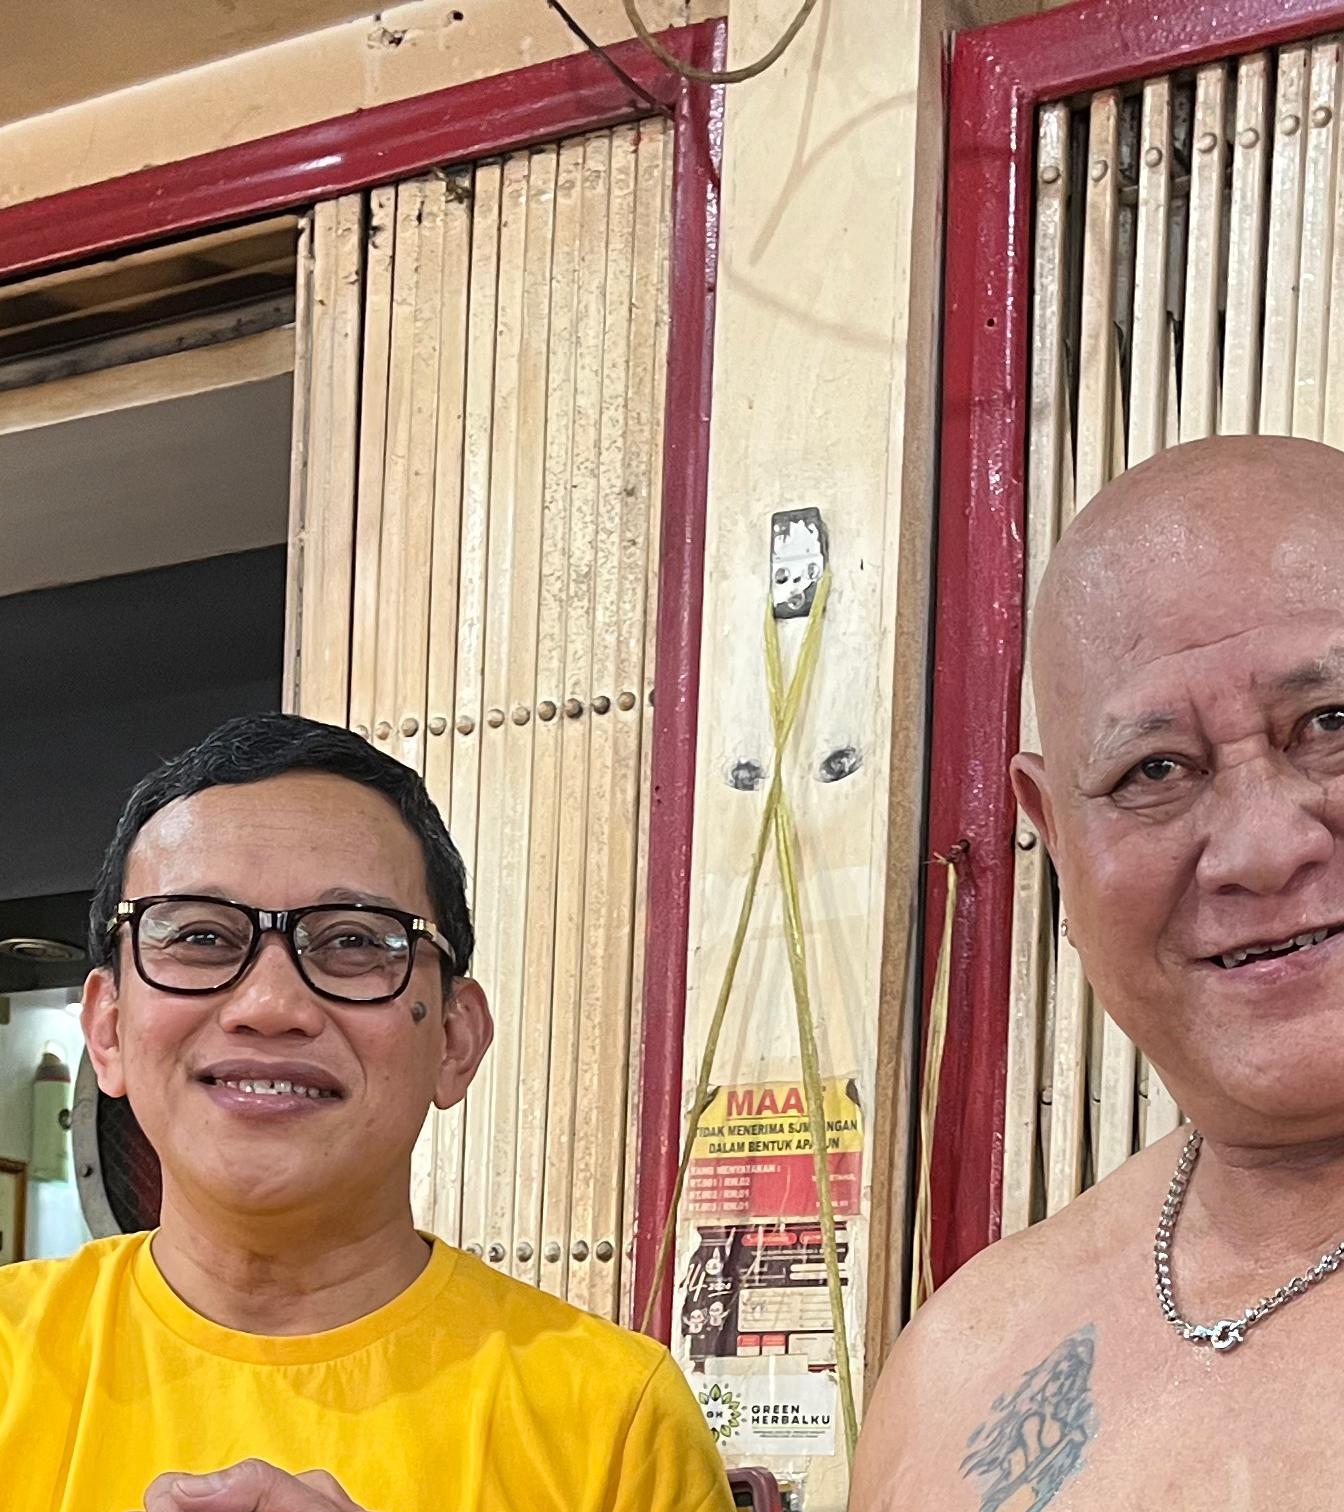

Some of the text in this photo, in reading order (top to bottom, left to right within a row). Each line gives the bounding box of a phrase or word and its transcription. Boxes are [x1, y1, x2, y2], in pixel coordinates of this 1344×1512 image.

[726, 1087, 826, 1116] MAA
[727, 1122, 785, 1138] MENERIMA
[708, 1140, 745, 1154] DALAM
[748, 1139, 794, 1153] BENTUK
[751, 1405, 800, 1414] GREEN
[751, 1415, 830, 1425] HERBALKU
